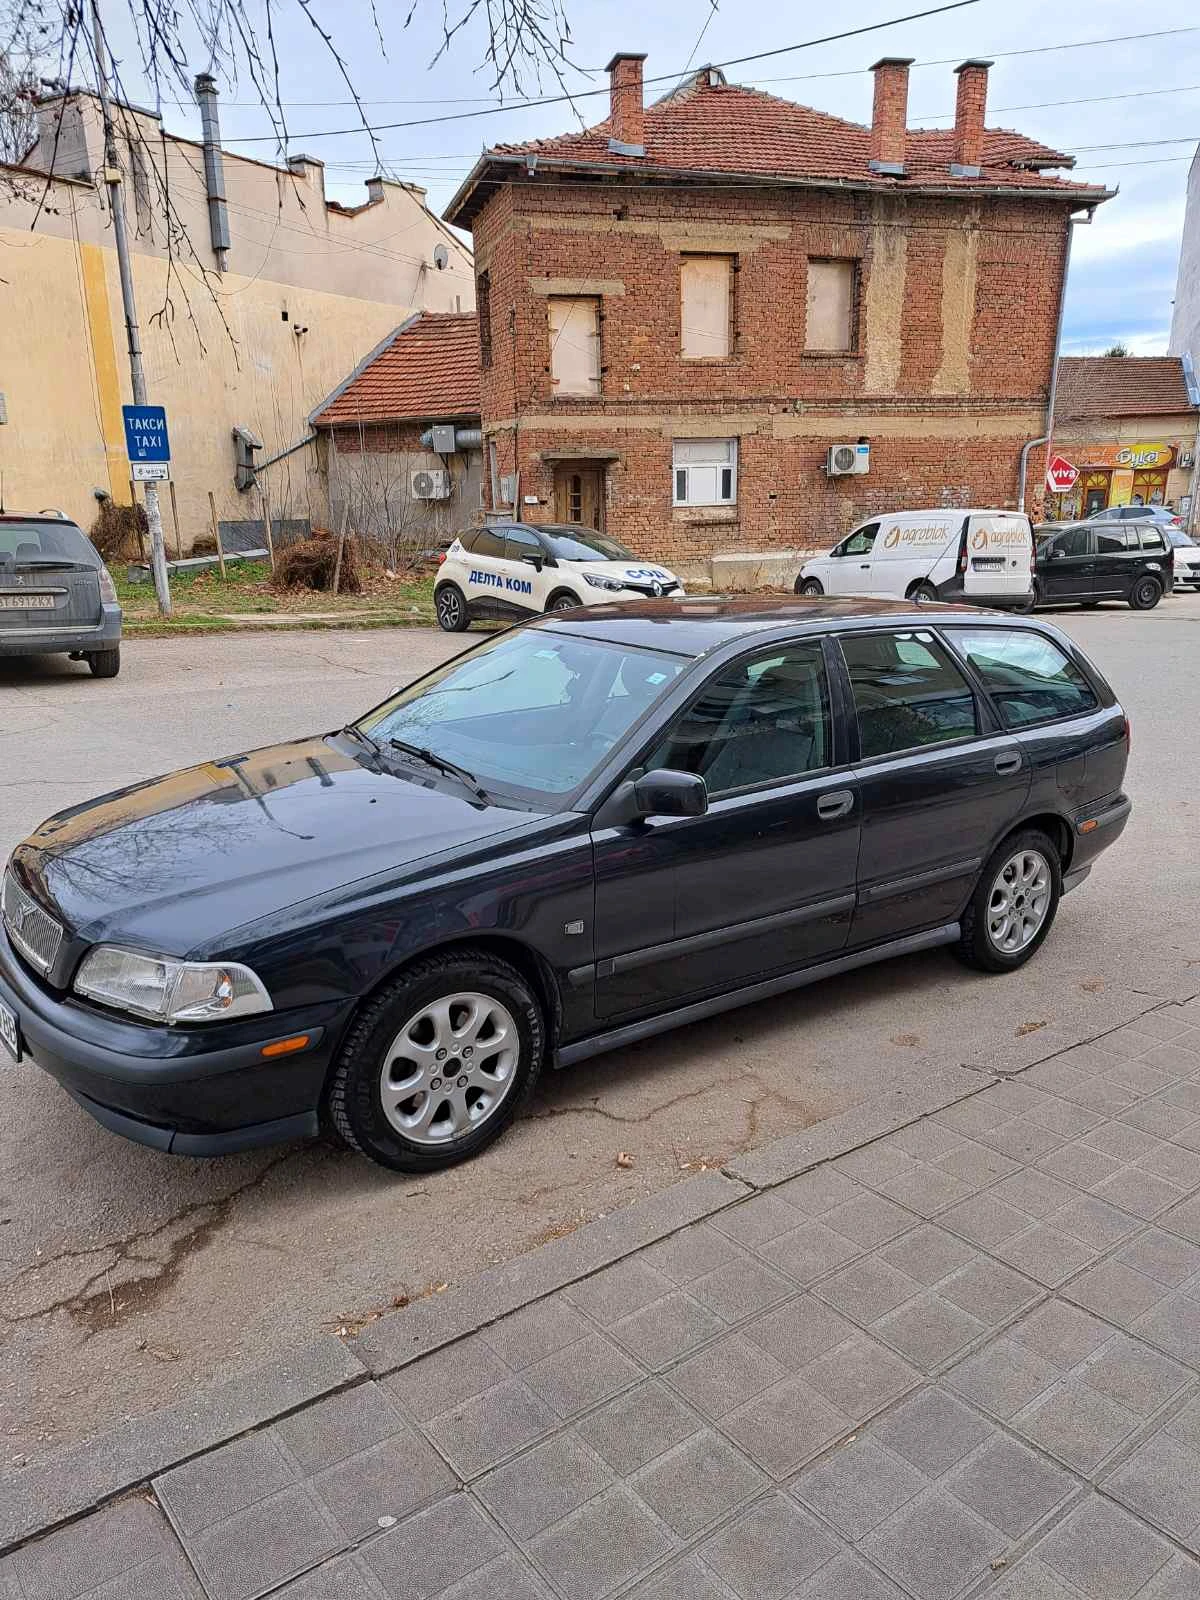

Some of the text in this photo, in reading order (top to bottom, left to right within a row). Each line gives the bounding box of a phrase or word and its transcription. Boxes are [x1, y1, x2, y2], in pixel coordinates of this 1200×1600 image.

[128, 418, 164, 430] ТАКСИ
[134, 435, 162, 448] TAXI
[1052, 467, 1076, 479] viva
[902, 523, 949, 545] agroblok
[990, 527, 1028, 547] agroblok
[469, 570, 532, 595] ДЕЛТА КОМ
